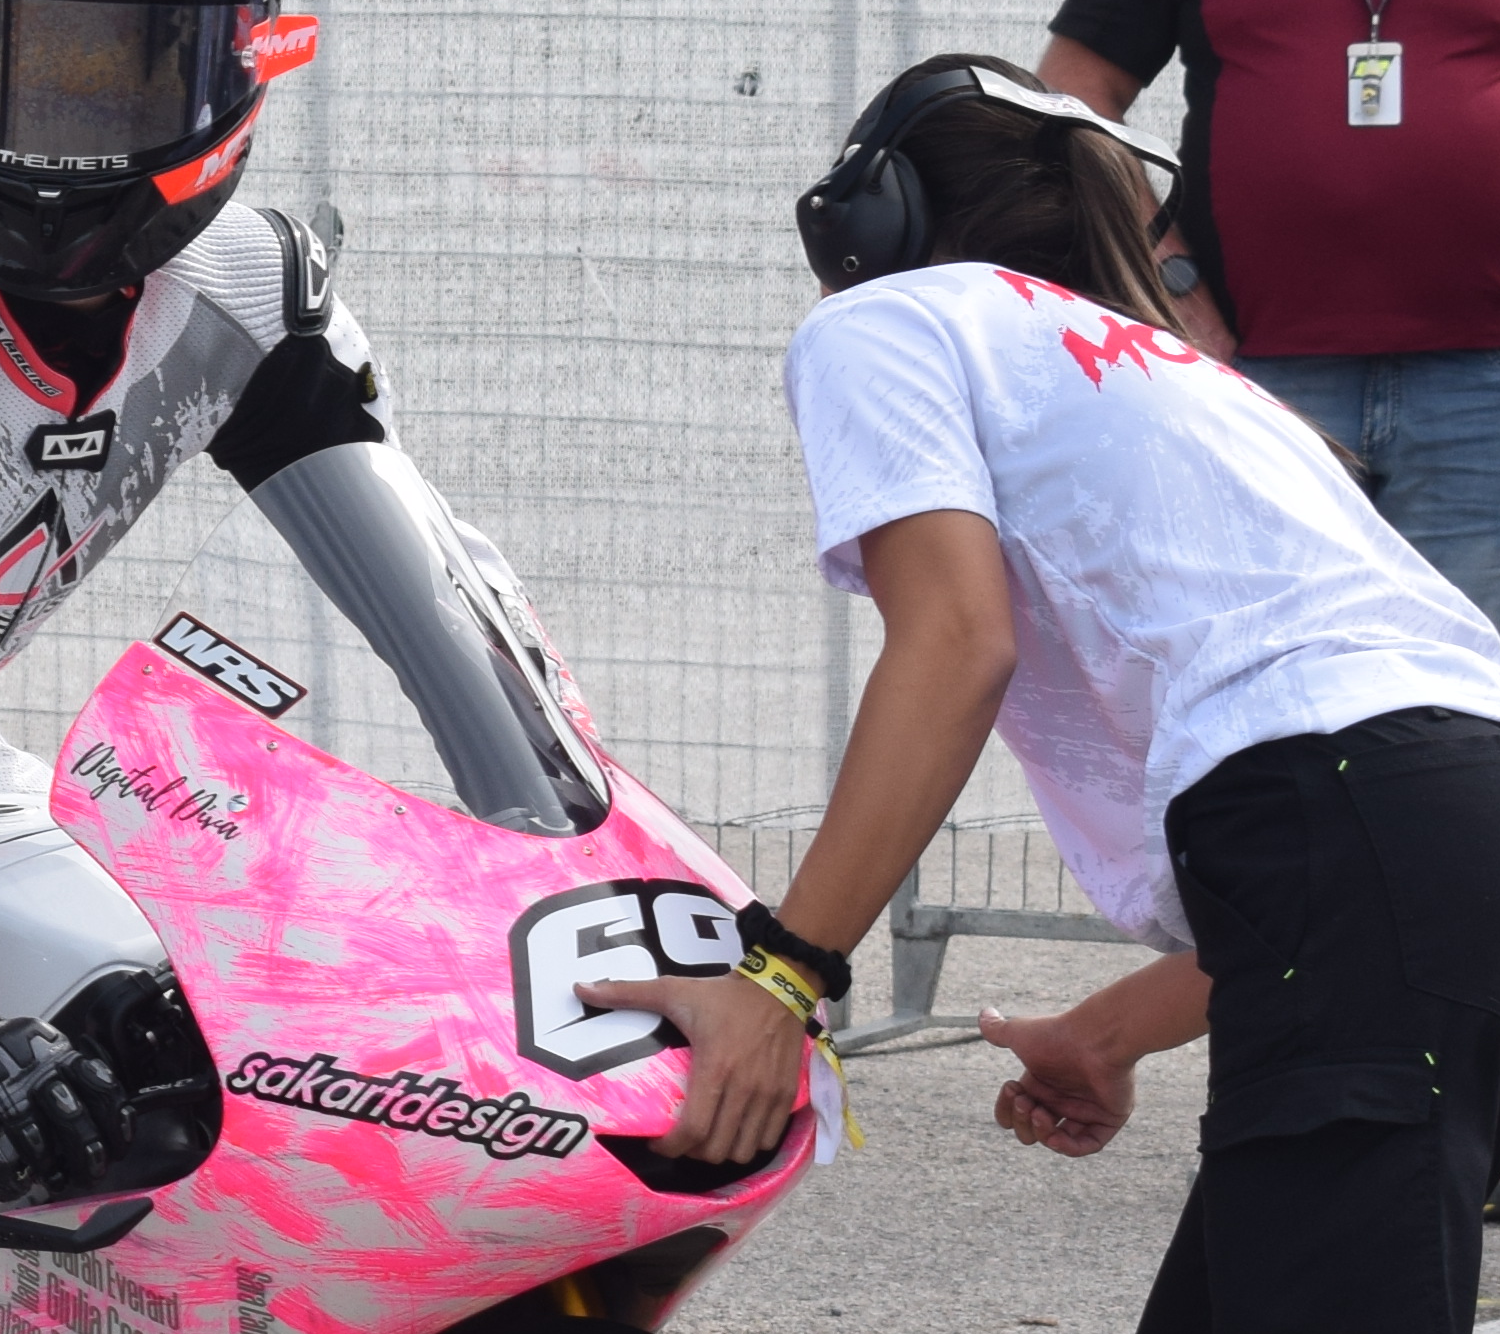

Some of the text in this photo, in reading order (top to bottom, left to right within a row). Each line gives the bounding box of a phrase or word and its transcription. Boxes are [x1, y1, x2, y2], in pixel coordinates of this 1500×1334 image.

[2, 338, 60, 398] RACING
[43, 431, 104, 461] AWA
[160, 617, 299, 707] WRS
[70, 741, 242, 841] Digital Diva
[771, 971, 815, 1013] 2025
[231, 1055, 583, 1155] sakartdesign
[107, 1263, 180, 1331] Everard
